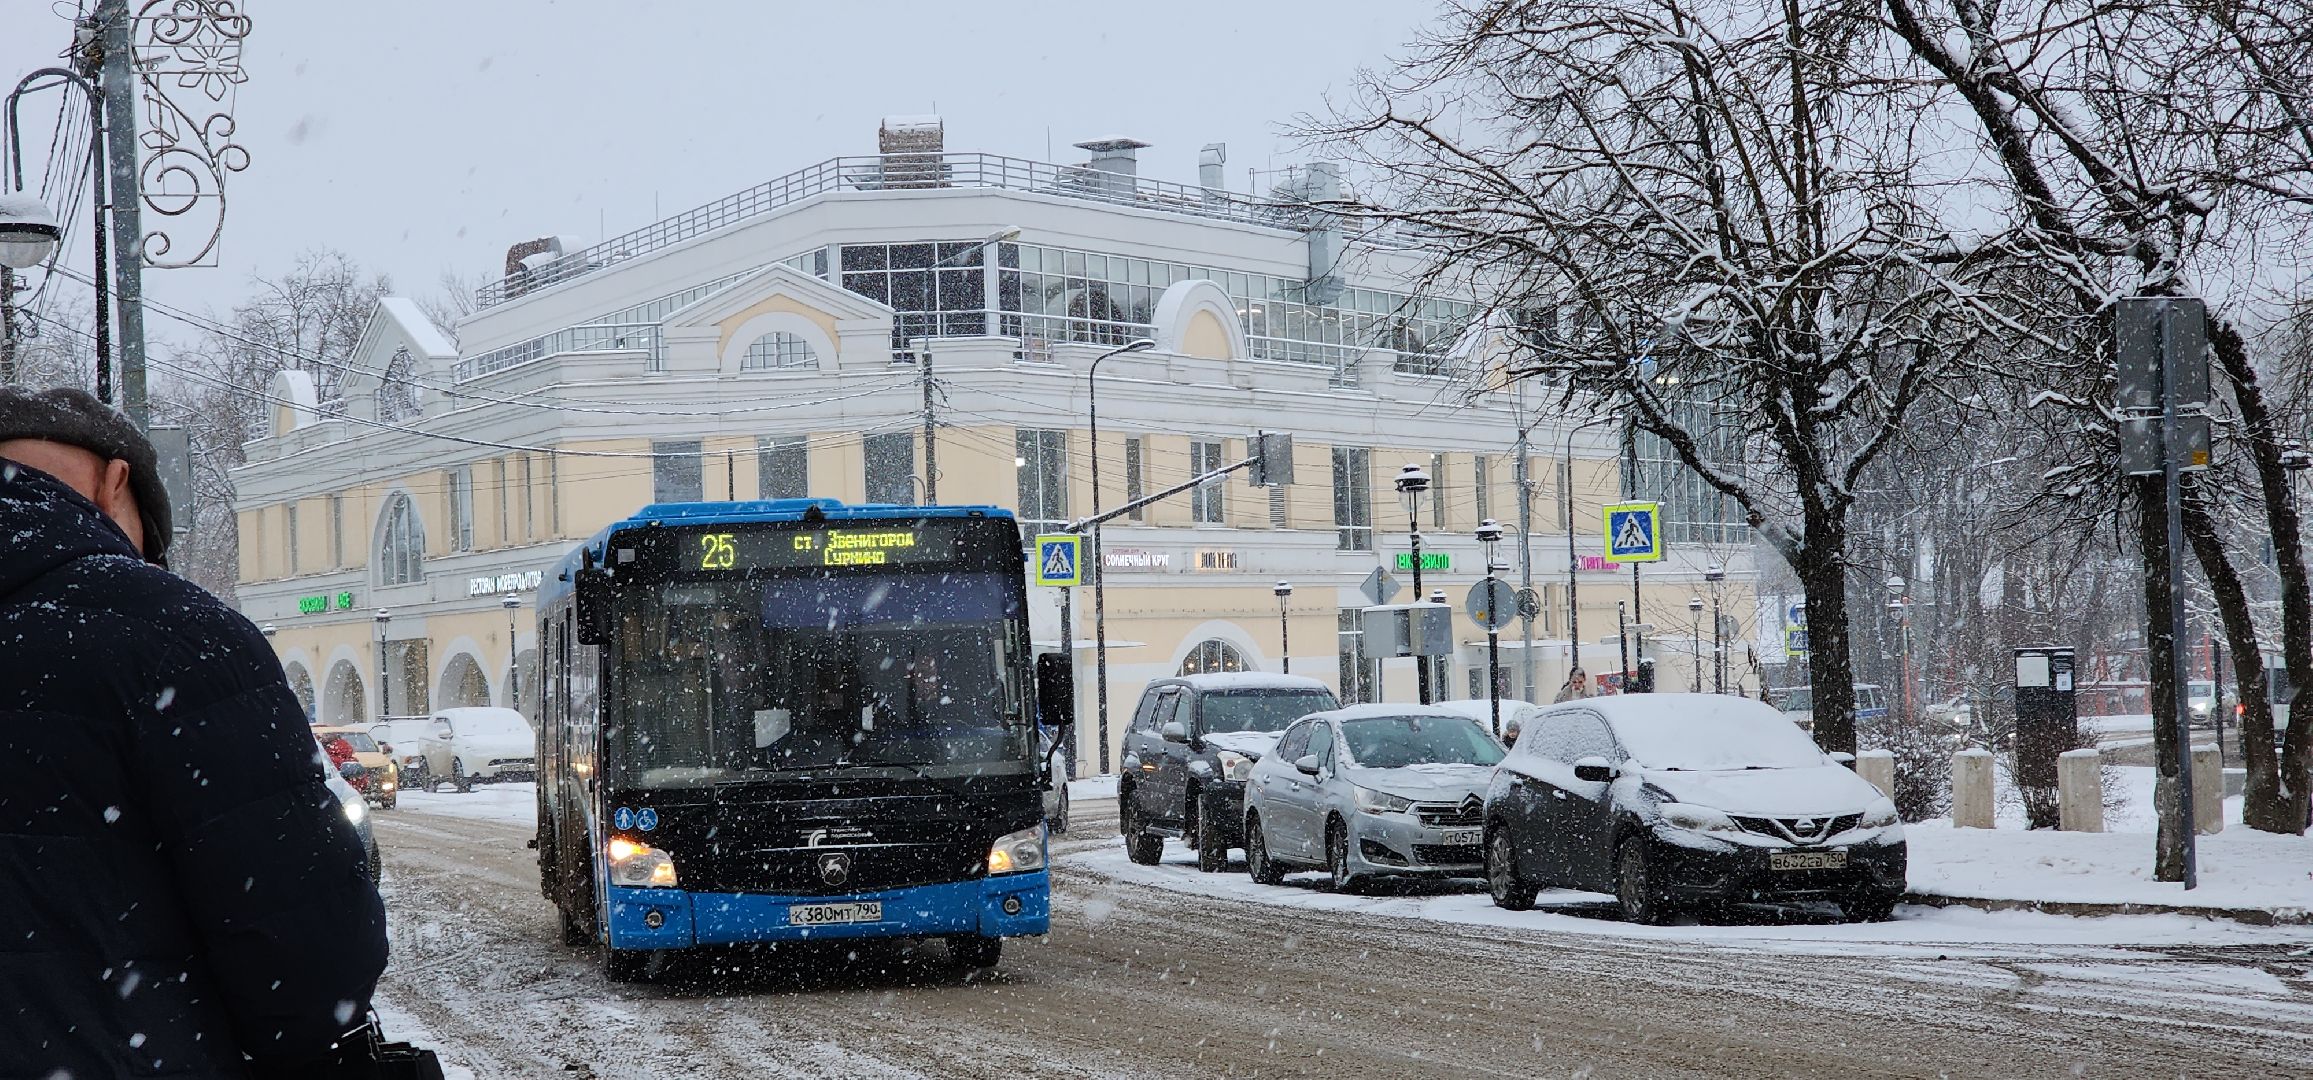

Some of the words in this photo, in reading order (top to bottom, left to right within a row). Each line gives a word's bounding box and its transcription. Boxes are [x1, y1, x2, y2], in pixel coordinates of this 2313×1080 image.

[701, 534, 734, 568] 25
[1105, 551, 1151, 567] СОЛНЕЧНЫЙ
[1152, 555, 1169, 567] КРУГ
[1397, 554, 1450, 569] ВКСВИЛЛ
[793, 907, 851, 922] К380МТ
[854, 903, 877, 916] 790
